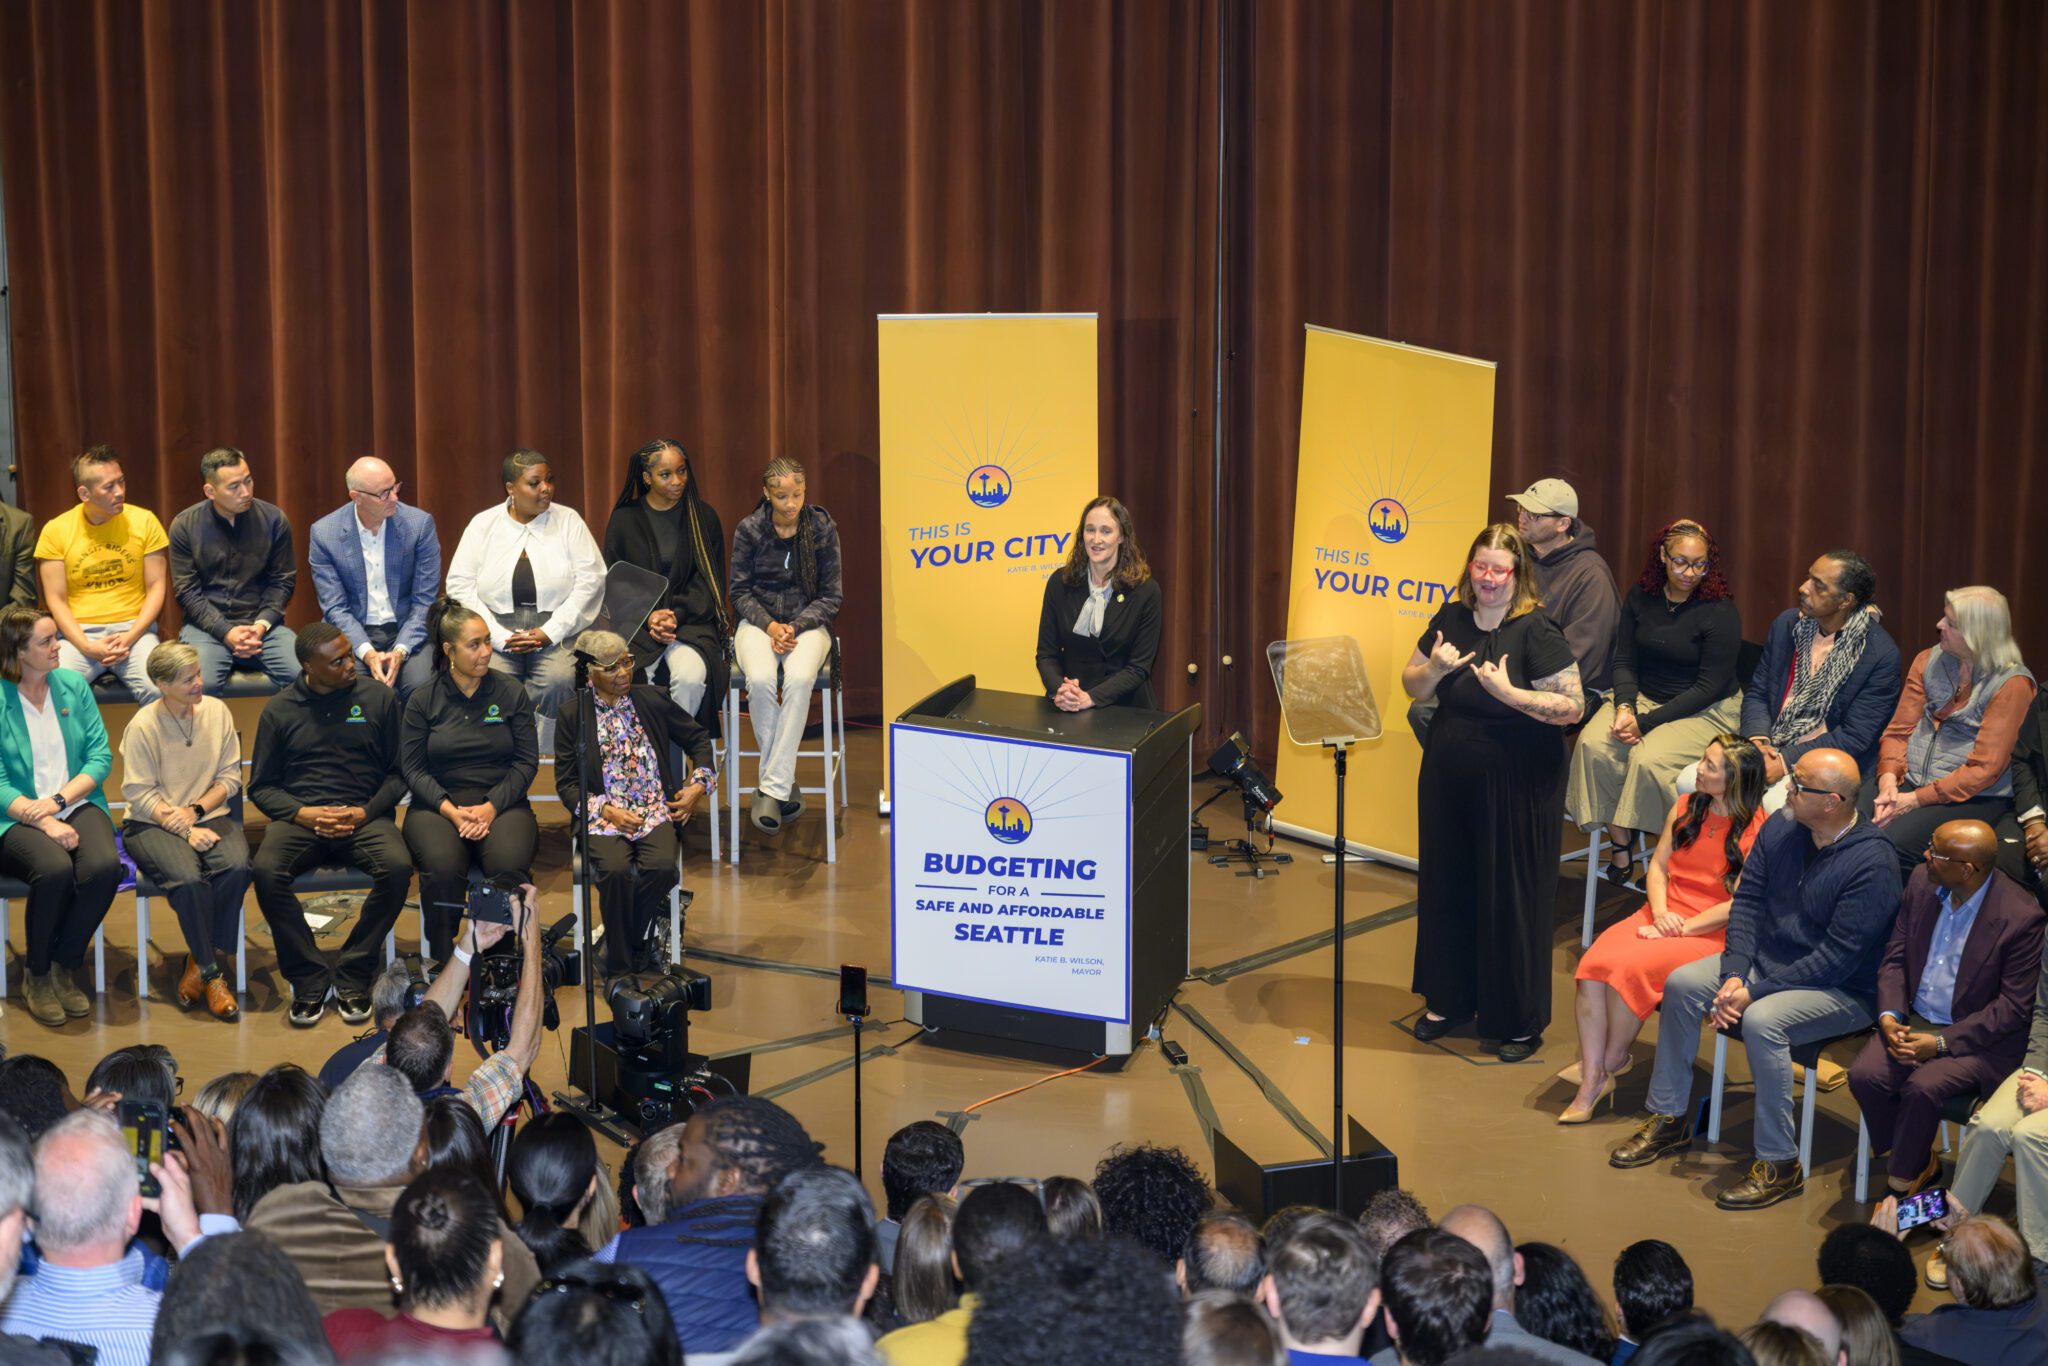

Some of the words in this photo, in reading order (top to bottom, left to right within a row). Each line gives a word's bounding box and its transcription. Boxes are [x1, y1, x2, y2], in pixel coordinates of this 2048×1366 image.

[908, 524, 949, 541] THIS
[955, 521, 971, 536] IS
[910, 540, 995, 569] YOUR
[1004, 532, 1071, 558] CITY
[1315, 547, 1350, 565] THIS
[1354, 552, 1370, 566] IS
[1008, 565, 1029, 574] KATIE
[1314, 568, 1390, 598] YOUR
[1397, 578, 1457, 605] CITY
[923, 852, 1097, 881] BUDGETING
[988, 885, 1016, 897] FOR
[1019, 887, 1030, 897] A
[915, 899, 955, 913] SAFE
[958, 902, 994, 915] AND
[997, 904, 1105, 920] AFFORDABLE
[954, 923, 1065, 946] SEATTLE
[1035, 955, 1058, 964] KATIE
[1069, 957, 1105, 967] WILSON,
[1071, 968, 1102, 976] MAYOR
